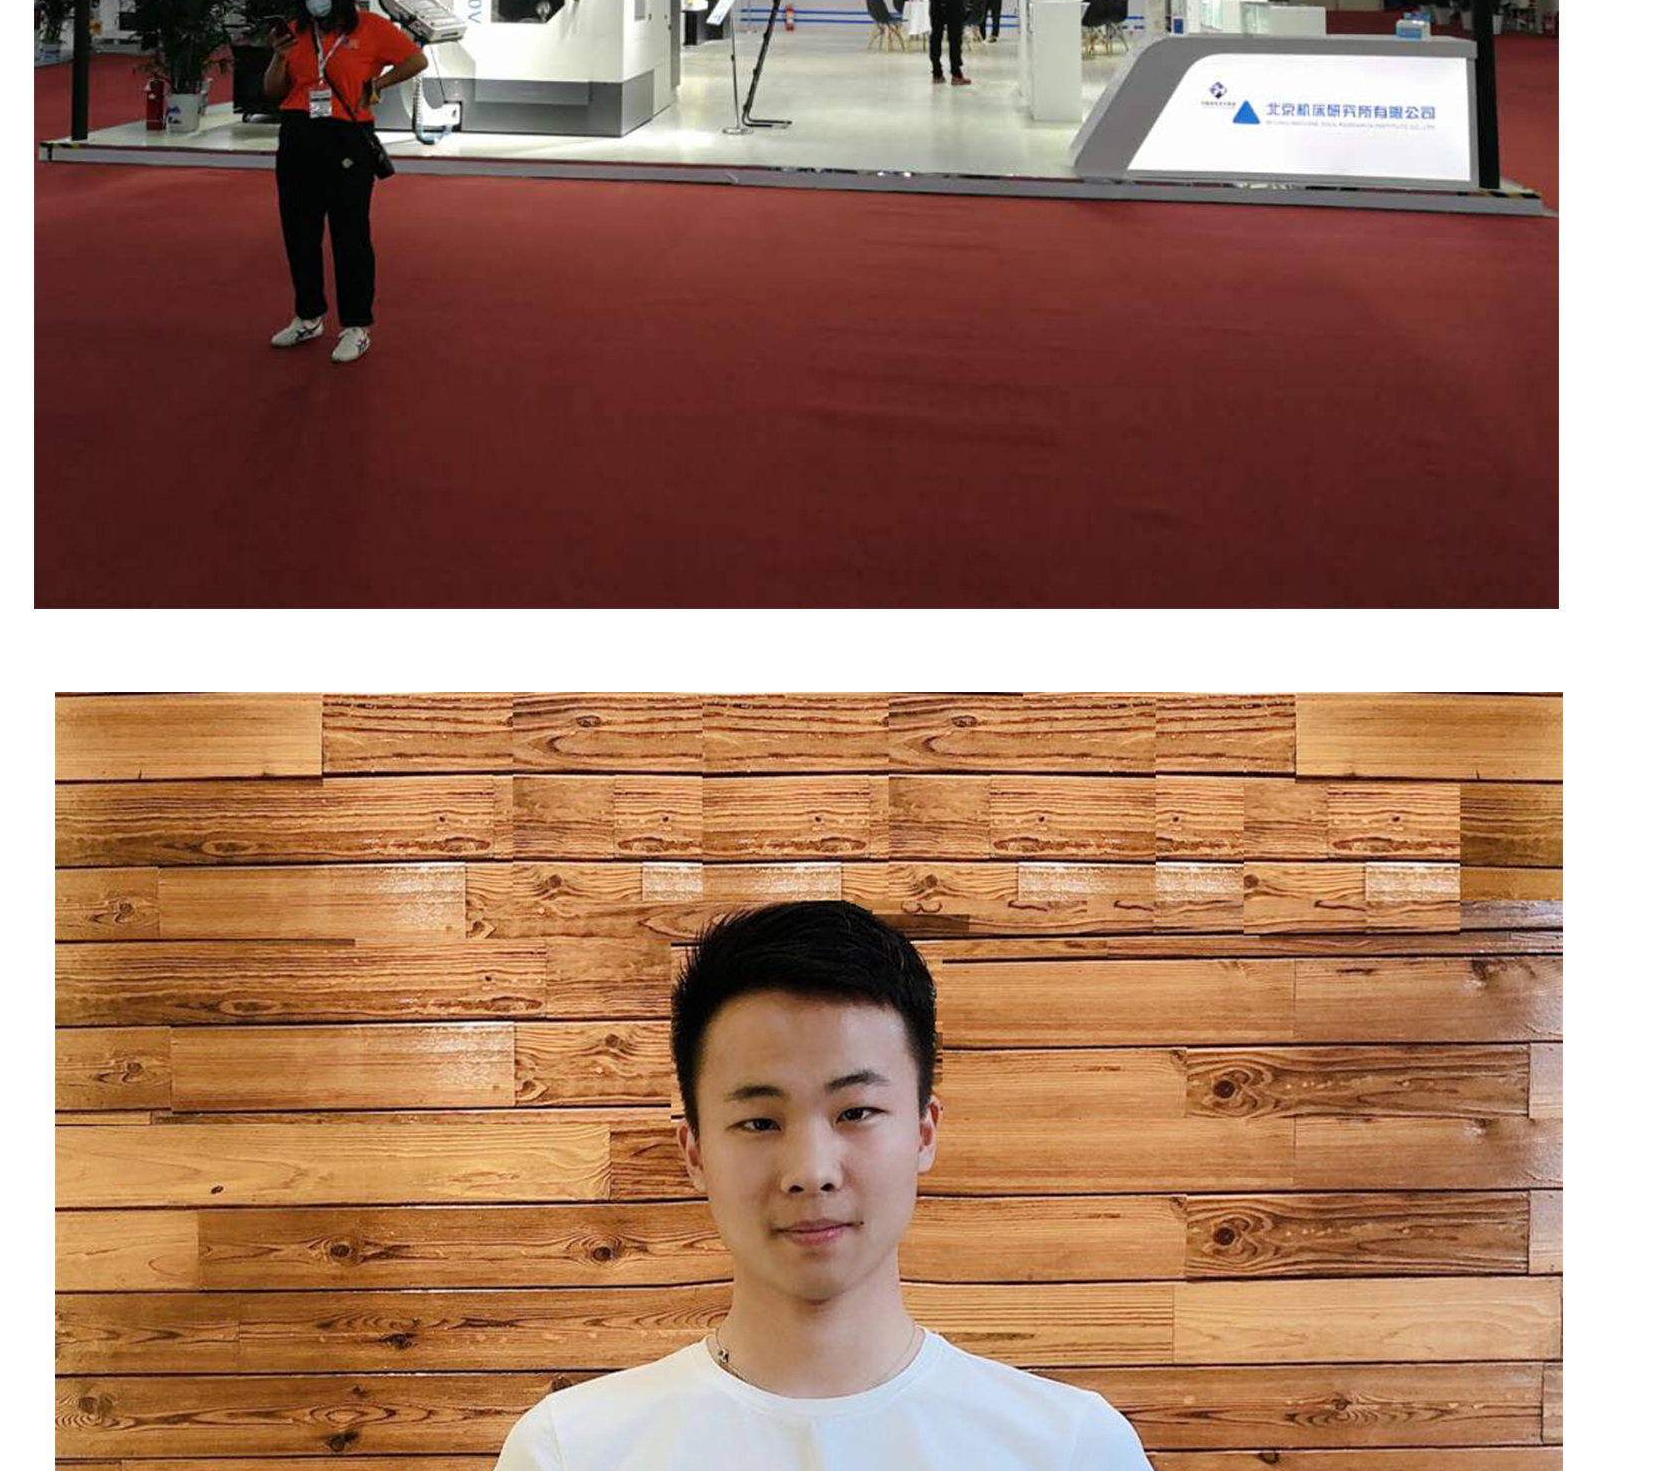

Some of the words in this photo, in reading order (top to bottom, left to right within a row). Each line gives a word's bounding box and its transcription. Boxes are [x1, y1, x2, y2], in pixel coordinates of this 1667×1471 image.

[1266, 102, 1436, 120] 北京机床研究所有限公司
